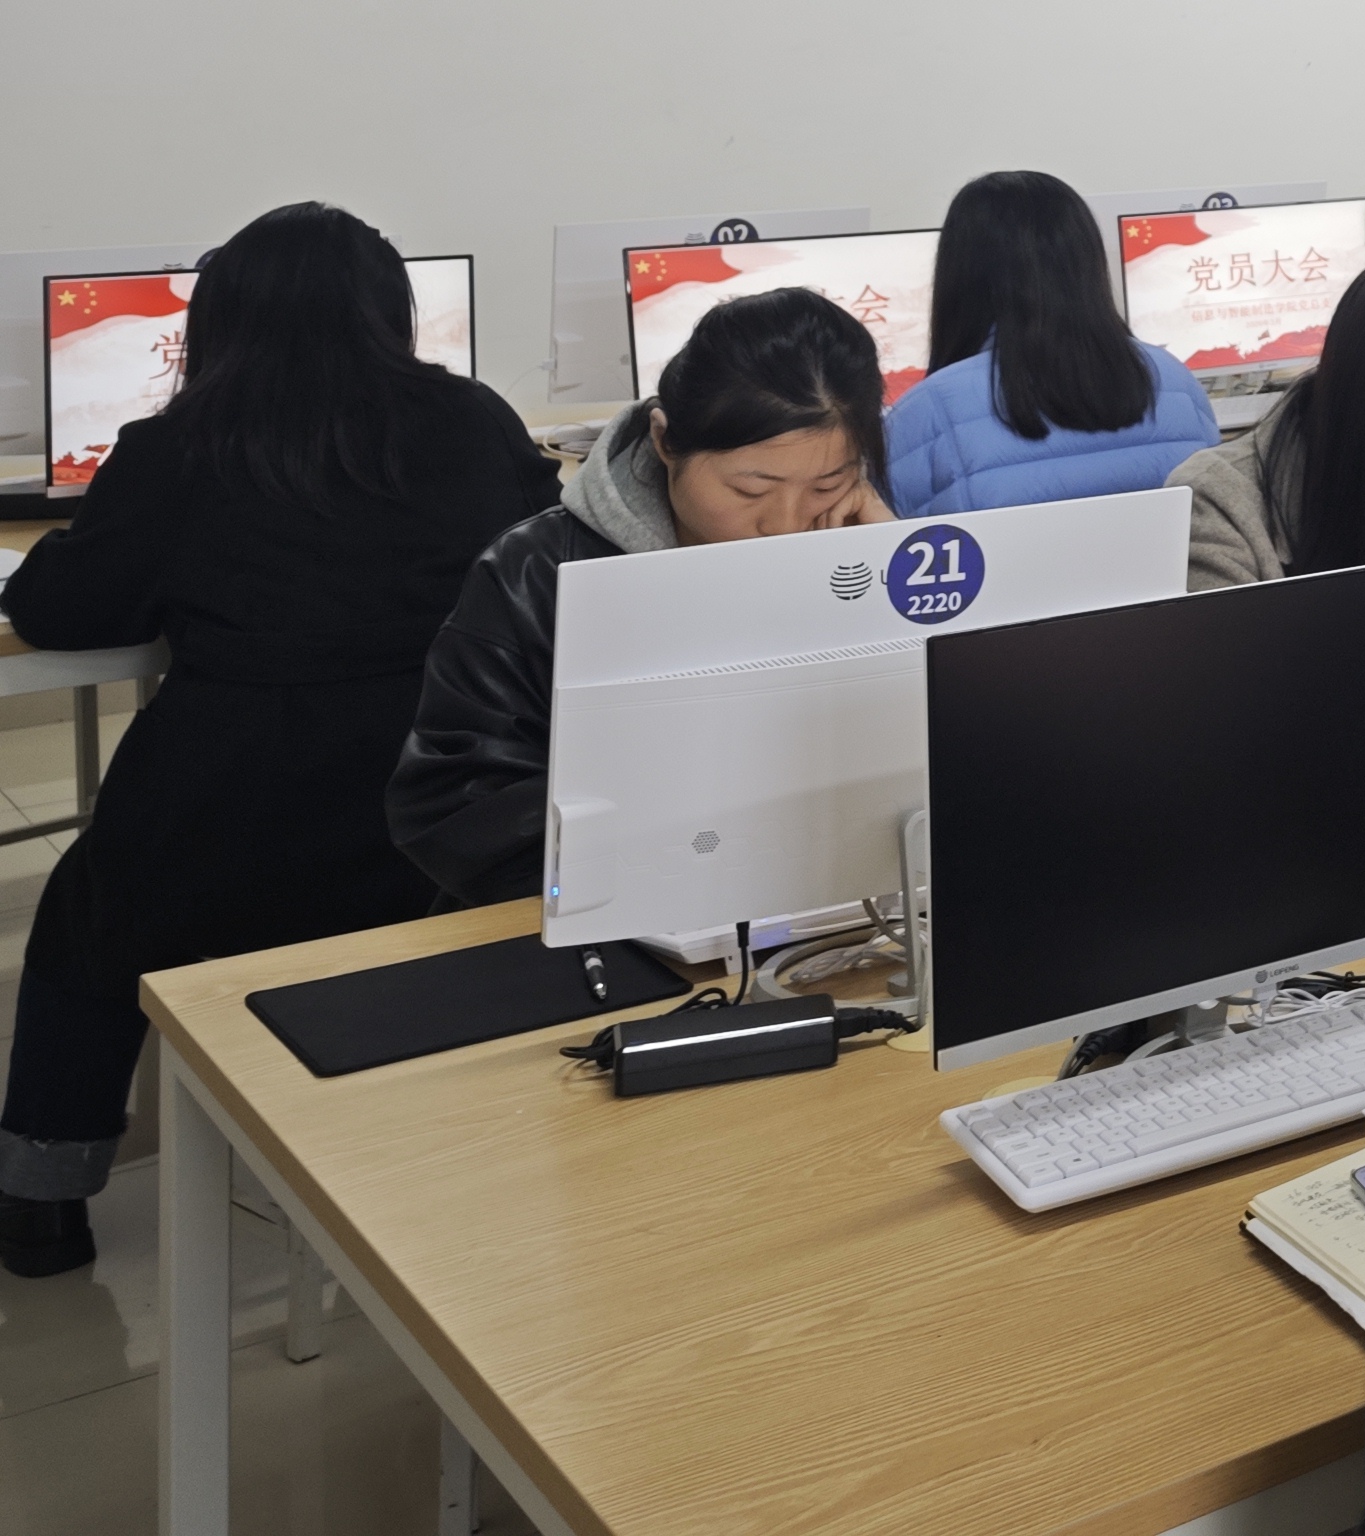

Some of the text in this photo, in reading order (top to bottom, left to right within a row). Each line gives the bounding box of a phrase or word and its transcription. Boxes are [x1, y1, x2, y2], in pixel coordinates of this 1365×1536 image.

[1187, 247, 1329, 294] 党员大会
[906, 539, 966, 586] 21
[907, 591, 962, 615] 2220
